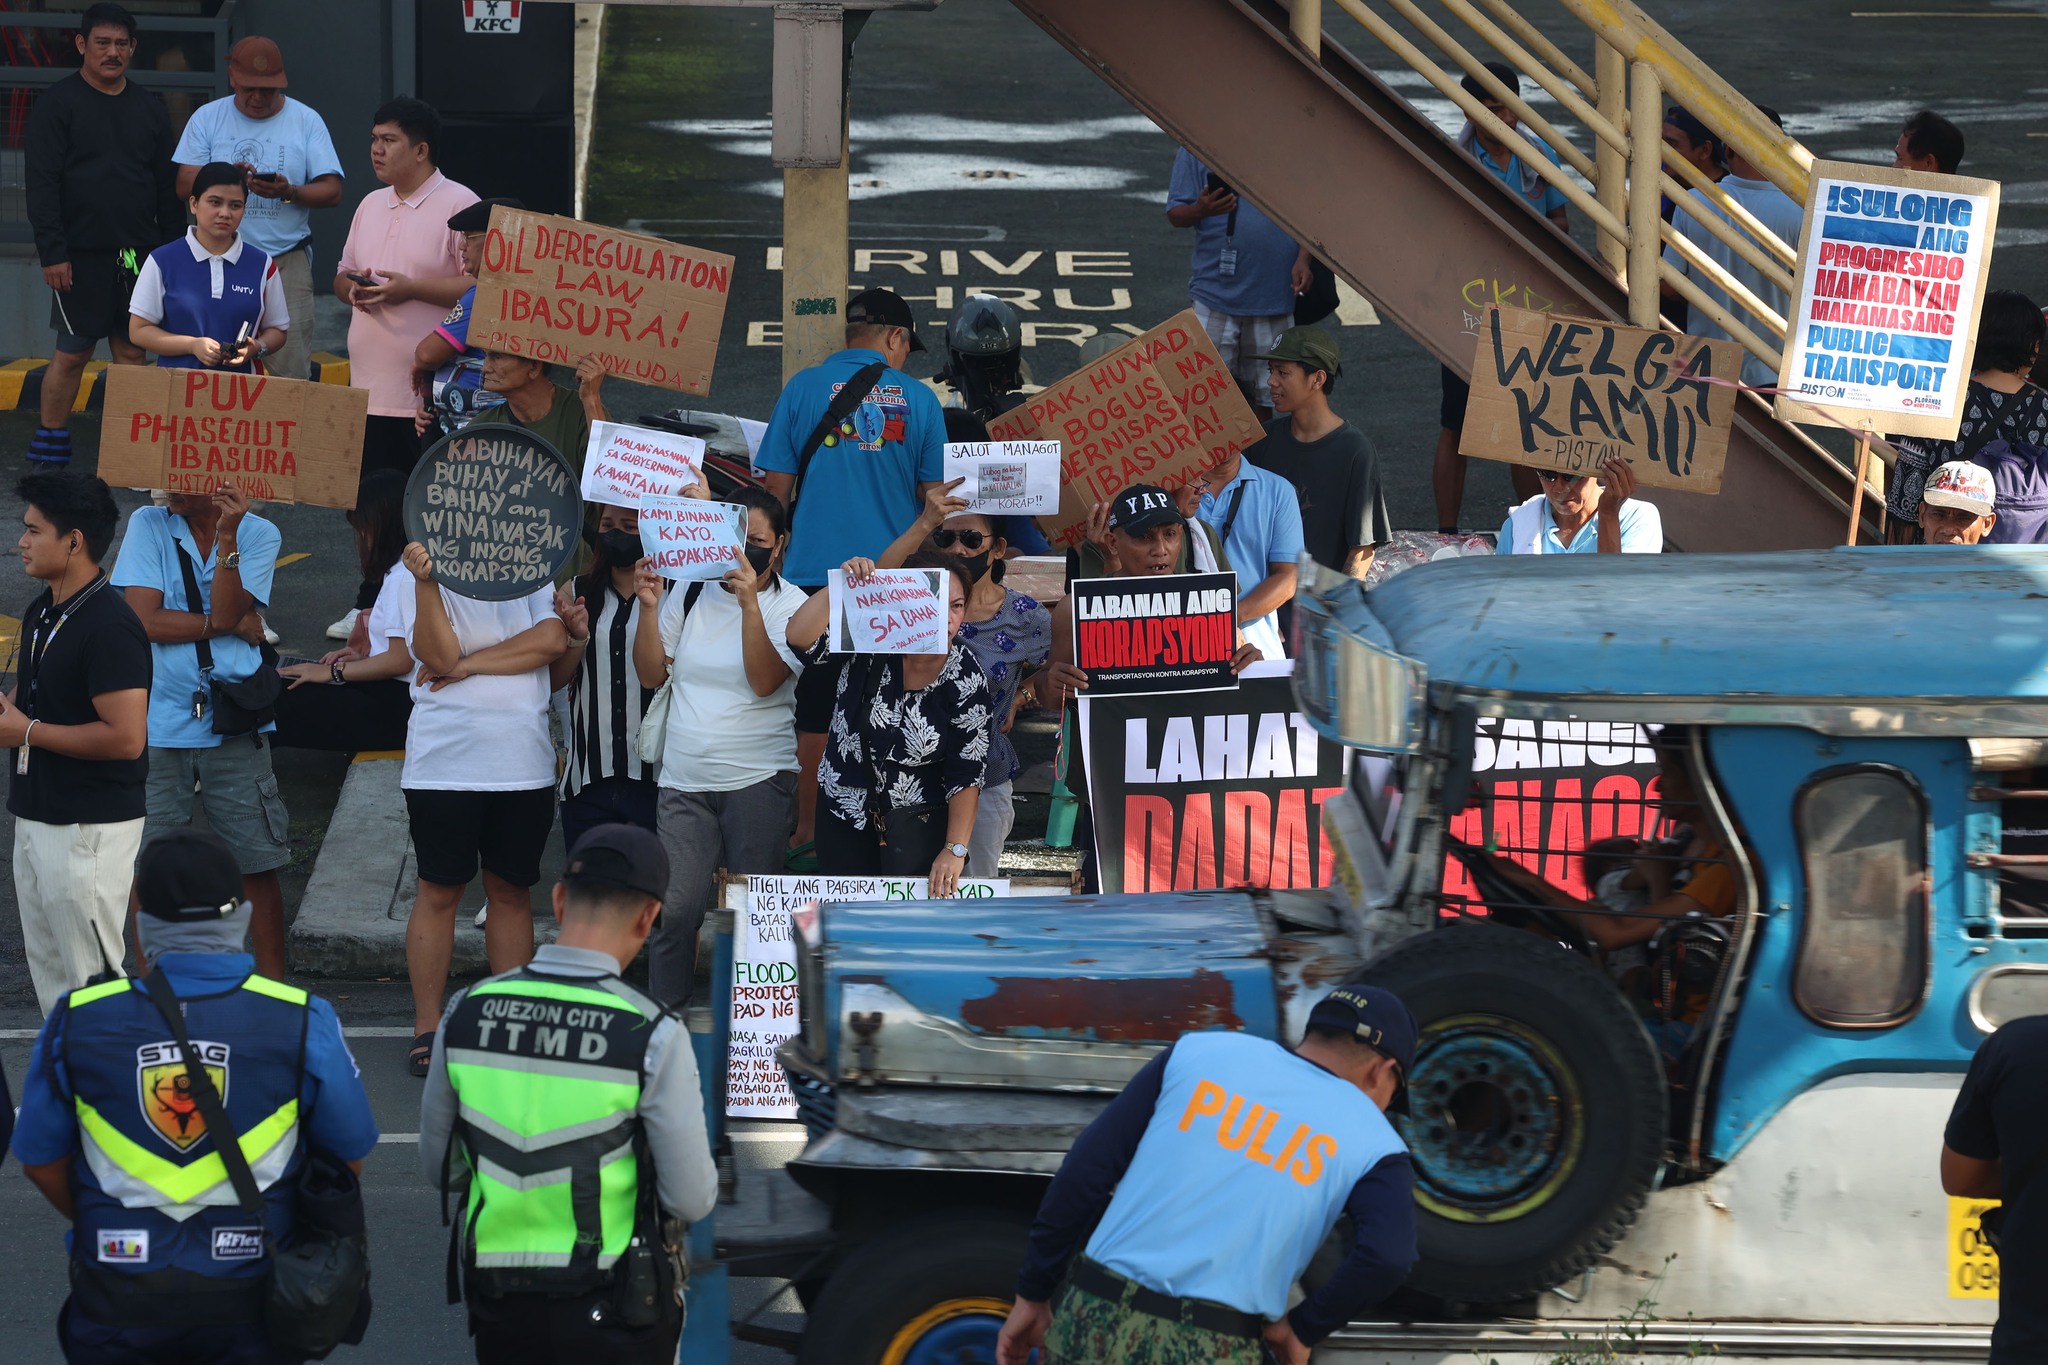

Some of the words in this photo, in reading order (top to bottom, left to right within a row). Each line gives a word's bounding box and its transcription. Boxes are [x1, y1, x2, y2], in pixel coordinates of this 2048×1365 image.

[473, 18, 512, 31] KFC
[1826, 185, 1973, 227] ISULONG
[1918, 226, 1969, 254] ANG
[484, 228, 533, 274] OIL
[534, 225, 728, 294] DEREGULATION
[766, 248, 1133, 276] RIVE
[1818, 241, 1965, 281] PROGRESIBO
[231, 284, 254, 295] UNTV
[555, 265, 644, 309] LAW,
[1813, 268, 1960, 312] MAKABAYAN
[501, 289, 690, 349] IBASURA!
[1810, 299, 1955, 336] MAKAMASANG
[1806, 324, 1891, 357] PUBLIC
[1088, 328, 1188, 395] HUWAD
[1490, 308, 1712, 427] WELGA
[1803, 352, 1947, 393] TRANSPORT
[185, 371, 267, 412] PUV
[1062, 377, 1163, 446] BOGUS
[1175, 351, 1214, 380] NA
[1799, 383, 1846, 399] PISTON
[130, 412, 297, 448] PHASEOUT
[1510, 376, 1697, 478] KAMI!
[170, 443, 297, 477] IBASURA
[613, 435, 654, 455] WALANG
[951, 443, 992, 459] SALOT
[1003, 442, 1060, 456] MANAGOT
[1086, 405, 1224, 503] IBASURA!
[434, 460, 510, 492] BUHAY
[508, 473, 535, 499] at
[447, 437, 571, 498] KABUHAYAN
[604, 448, 619, 460] SA
[620, 452, 685, 479] GUBYERNONG
[427, 483, 507, 517] BAHAY
[507, 504, 552, 531] ang
[998, 495, 1043, 510] KORAP!!
[1125, 492, 1168, 515] YAP
[427, 536, 460, 560] NG
[470, 541, 543, 565] INYONG
[436, 558, 552, 585] KORAPSYON
[1078, 591, 1181, 620] LABANAN
[1186, 588, 1232, 615] ANG
[869, 614, 901, 642] SA
[900, 603, 940, 628] BAHA!
[1079, 612, 1233, 669] KORAPSYON!
[1097, 672, 1155, 681] TRANSPORTASYON
[1155, 670, 1181, 679] KONTRA
[1181, 667, 1219, 677] KORAPSYON
[1124, 712, 1319, 783] LAHAT
[749, 876, 788, 895] ITIGIL
[793, 878, 820, 895] ANG
[826, 879, 876, 895] PAGSIRA
[757, 896, 775, 911] NG
[481, 998, 563, 1025] QUEZON
[566, 1008, 615, 1031] CITY
[733, 1003, 765, 1019] PAD
[772, 1002, 794, 1019] NG
[1329, 991, 1368, 1008] PULIS
[729, 1030, 758, 1043] NASA
[728, 1059, 749, 1071] PAY
[753, 1060, 770, 1071] NG
[752, 1071, 787, 1083] AYUDA
[726, 1096, 754, 1107] PADIN
[756, 1095, 776, 1107] ANG
[773, 1084, 787, 1094] AT
[1177, 1078, 1338, 1186] PULIS
